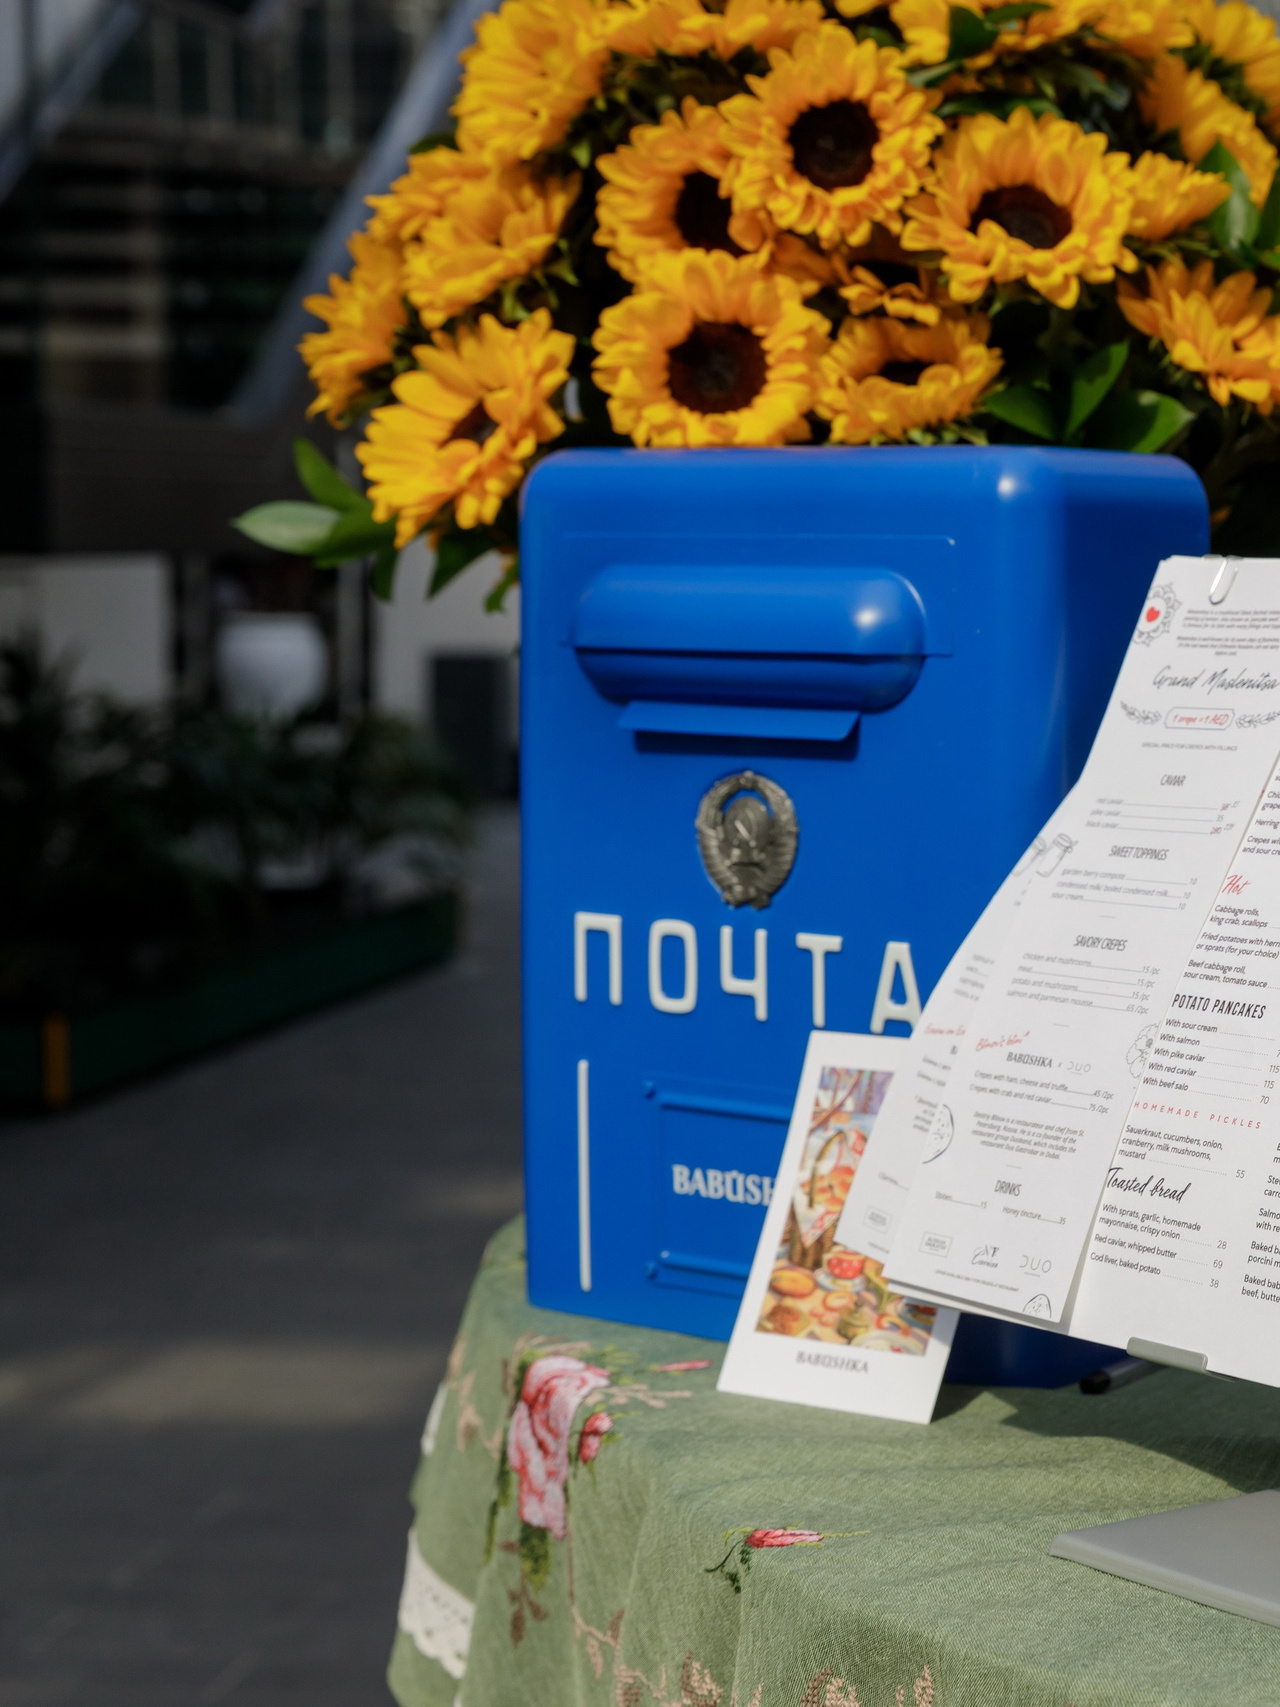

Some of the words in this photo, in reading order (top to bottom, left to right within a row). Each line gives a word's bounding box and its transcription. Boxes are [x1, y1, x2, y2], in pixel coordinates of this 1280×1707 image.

[1153, 665, 1206, 690] Grand
[1160, 774, 1186, 787] CAVIAR
[1108, 845, 1134, 859] SWEET
[1132, 847, 1170, 861] TOPPINGS
[1221, 871, 1251, 896] Hot
[1073, 934, 1101, 949] SAVORY
[1100, 938, 1128, 952] CREPES
[574, 910, 924, 1035] ПОЧТА
[1171, 993, 1211, 1012] POTATO
[1211, 998, 1267, 1020] PANCAKES
[1133, 1100, 1199, 1119] HOMEMADE
[1209, 1113, 1262, 1130] PICKLES
[994, 1179, 1022, 1197] DRINKS
[1106, 1166, 1154, 1196] Toasted
[1149, 1177, 1192, 1204] bread
